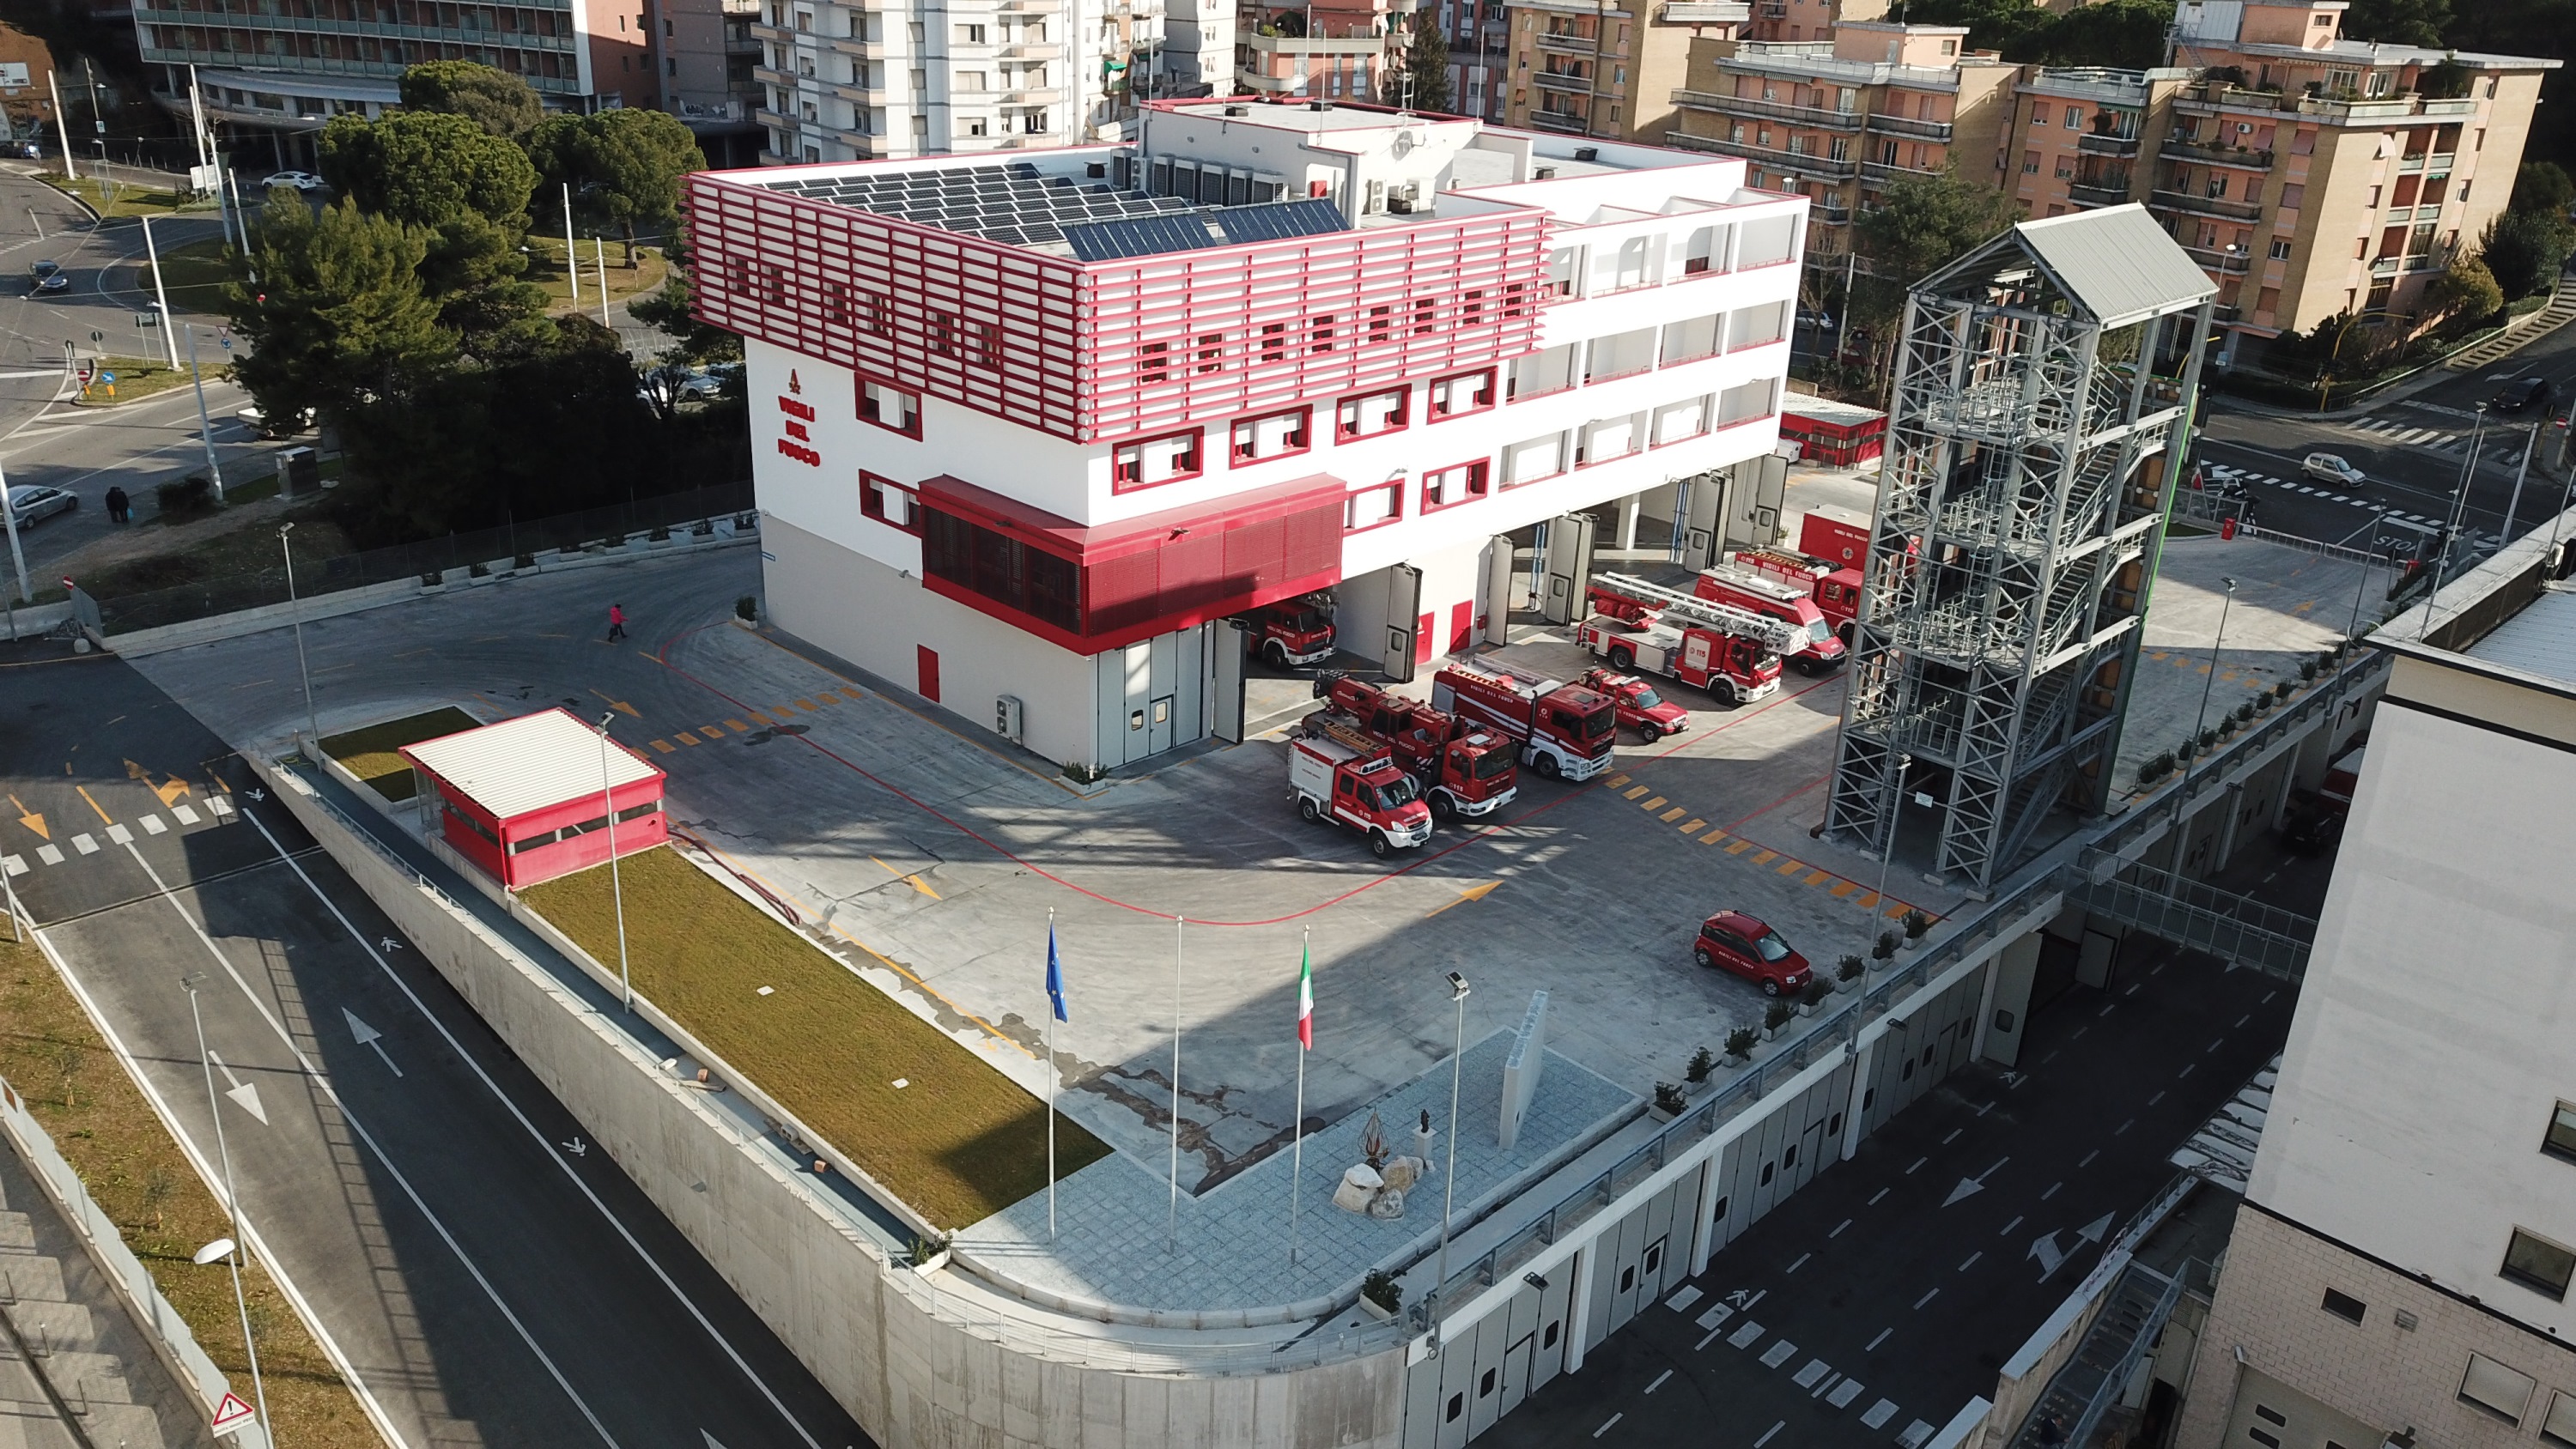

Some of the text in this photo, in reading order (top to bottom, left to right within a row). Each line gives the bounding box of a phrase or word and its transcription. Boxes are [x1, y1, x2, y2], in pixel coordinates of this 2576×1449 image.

[778, 396, 815, 422] VIGILI
[786, 420, 810, 442] DEL
[778, 439, 820, 467] FUOCO
[1763, 561, 1814, 581] VIGILI DEL FUOCO
[1696, 649, 1706, 658] 115
[1373, 730, 1386, 739] VIGILI
[1398, 740, 1416, 751] FUOCO
[1453, 783, 1464, 791] 115
